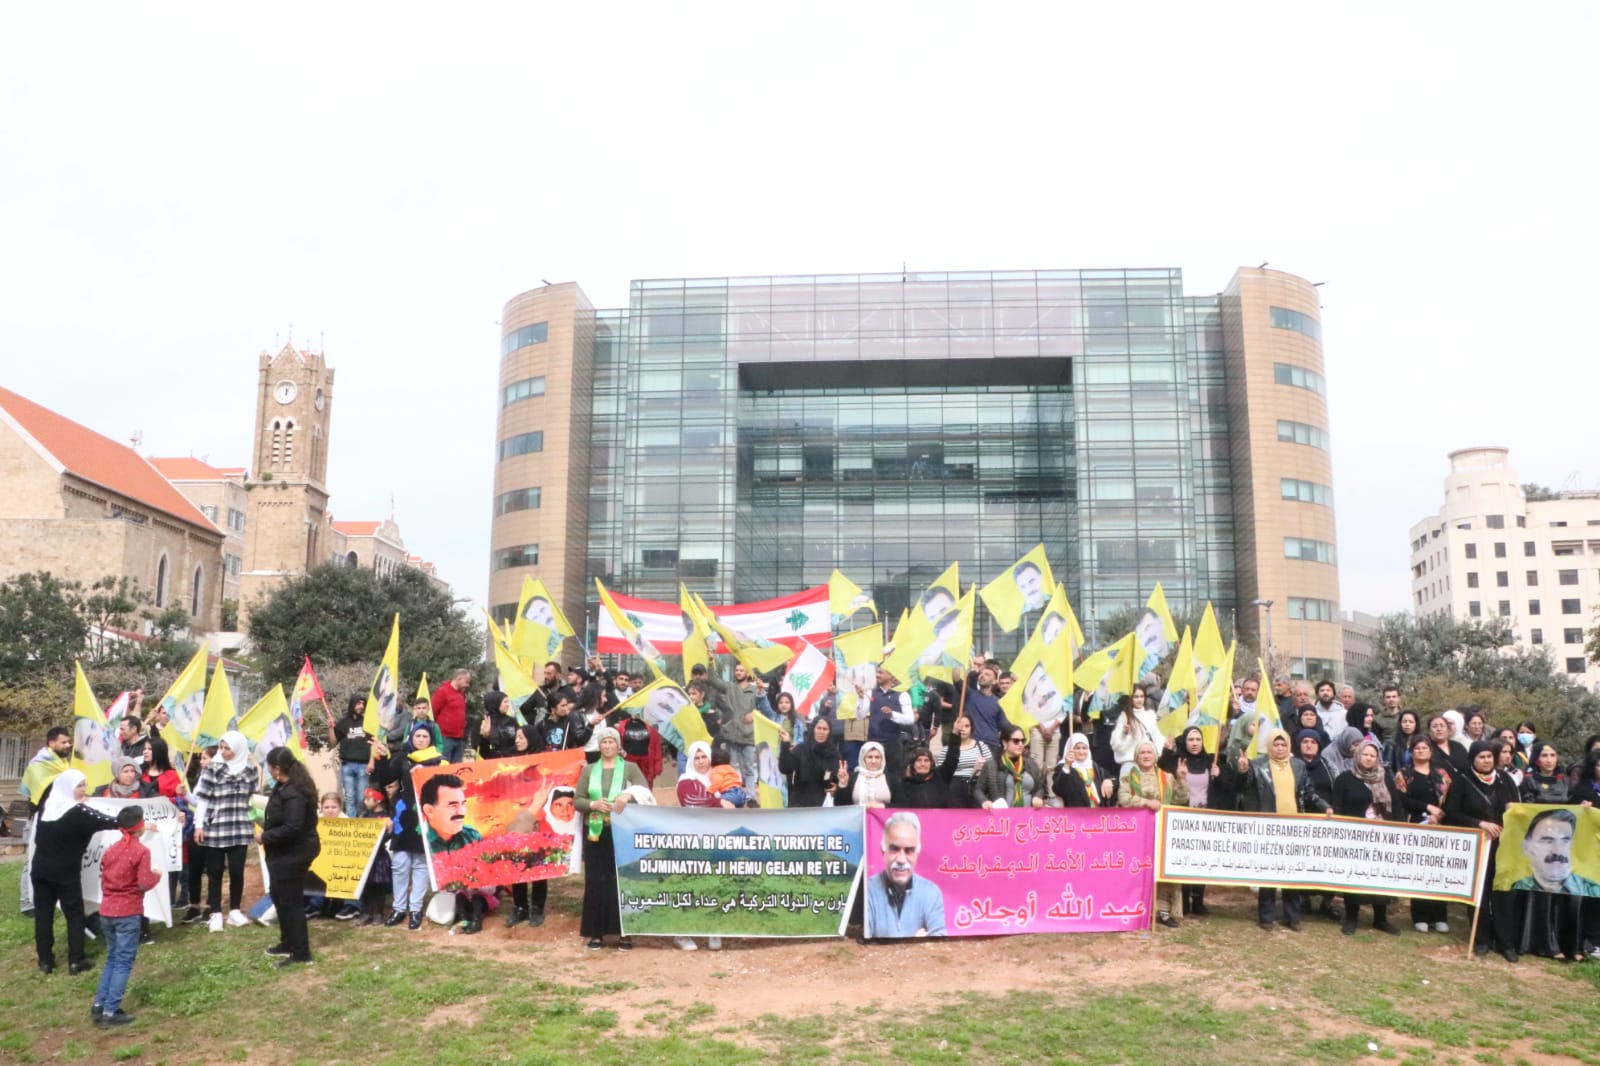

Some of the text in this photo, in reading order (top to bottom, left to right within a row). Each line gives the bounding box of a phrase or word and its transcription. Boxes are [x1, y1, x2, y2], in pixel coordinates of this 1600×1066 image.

[953, 814, 1137, 845] نطالب بالإفراج الفوري
[1172, 818, 1200, 832] CIVAKA
[1257, 824, 1264, 835] LI
[1382, 831, 1401, 845] XWE
[1402, 831, 1419, 847] YÊN
[1450, 838, 1461, 850] YE
[1462, 839, 1471, 852] DI
[633, 832, 700, 850] HEVKARIYA
[702, 834, 715, 850] BI
[717, 834, 771, 851] DEWLETA
[774, 834, 825, 851] TURKIYE
[827, 834, 843, 851] RE
[1171, 837, 1211, 852] PARASTINA
[1213, 838, 1231, 853] GELÊ
[1260, 840, 1284, 856] HÊZÊN
[1372, 847, 1383, 862] ÊN
[1384, 850, 1395, 863] KU
[1416, 853, 1445, 868] TERORÊ
[1446, 856, 1468, 870] KIRIN
[639, 858, 848, 876] DIJMINATIYA JI HEMU GELAN RE YE !
[938, 848, 1153, 879] عن قائد الأمة الديمقراطية
[628, 892, 669, 909] الشعوب
[672, 892, 692, 908] لكل
[694, 892, 719, 907] عداء
[721, 897, 736, 913] هي
[739, 893, 777, 912] التركية
[780, 893, 809, 911] الدولة
[811, 900, 825, 914] مع
[954, 882, 1147, 929] عبد الله أوجلان
